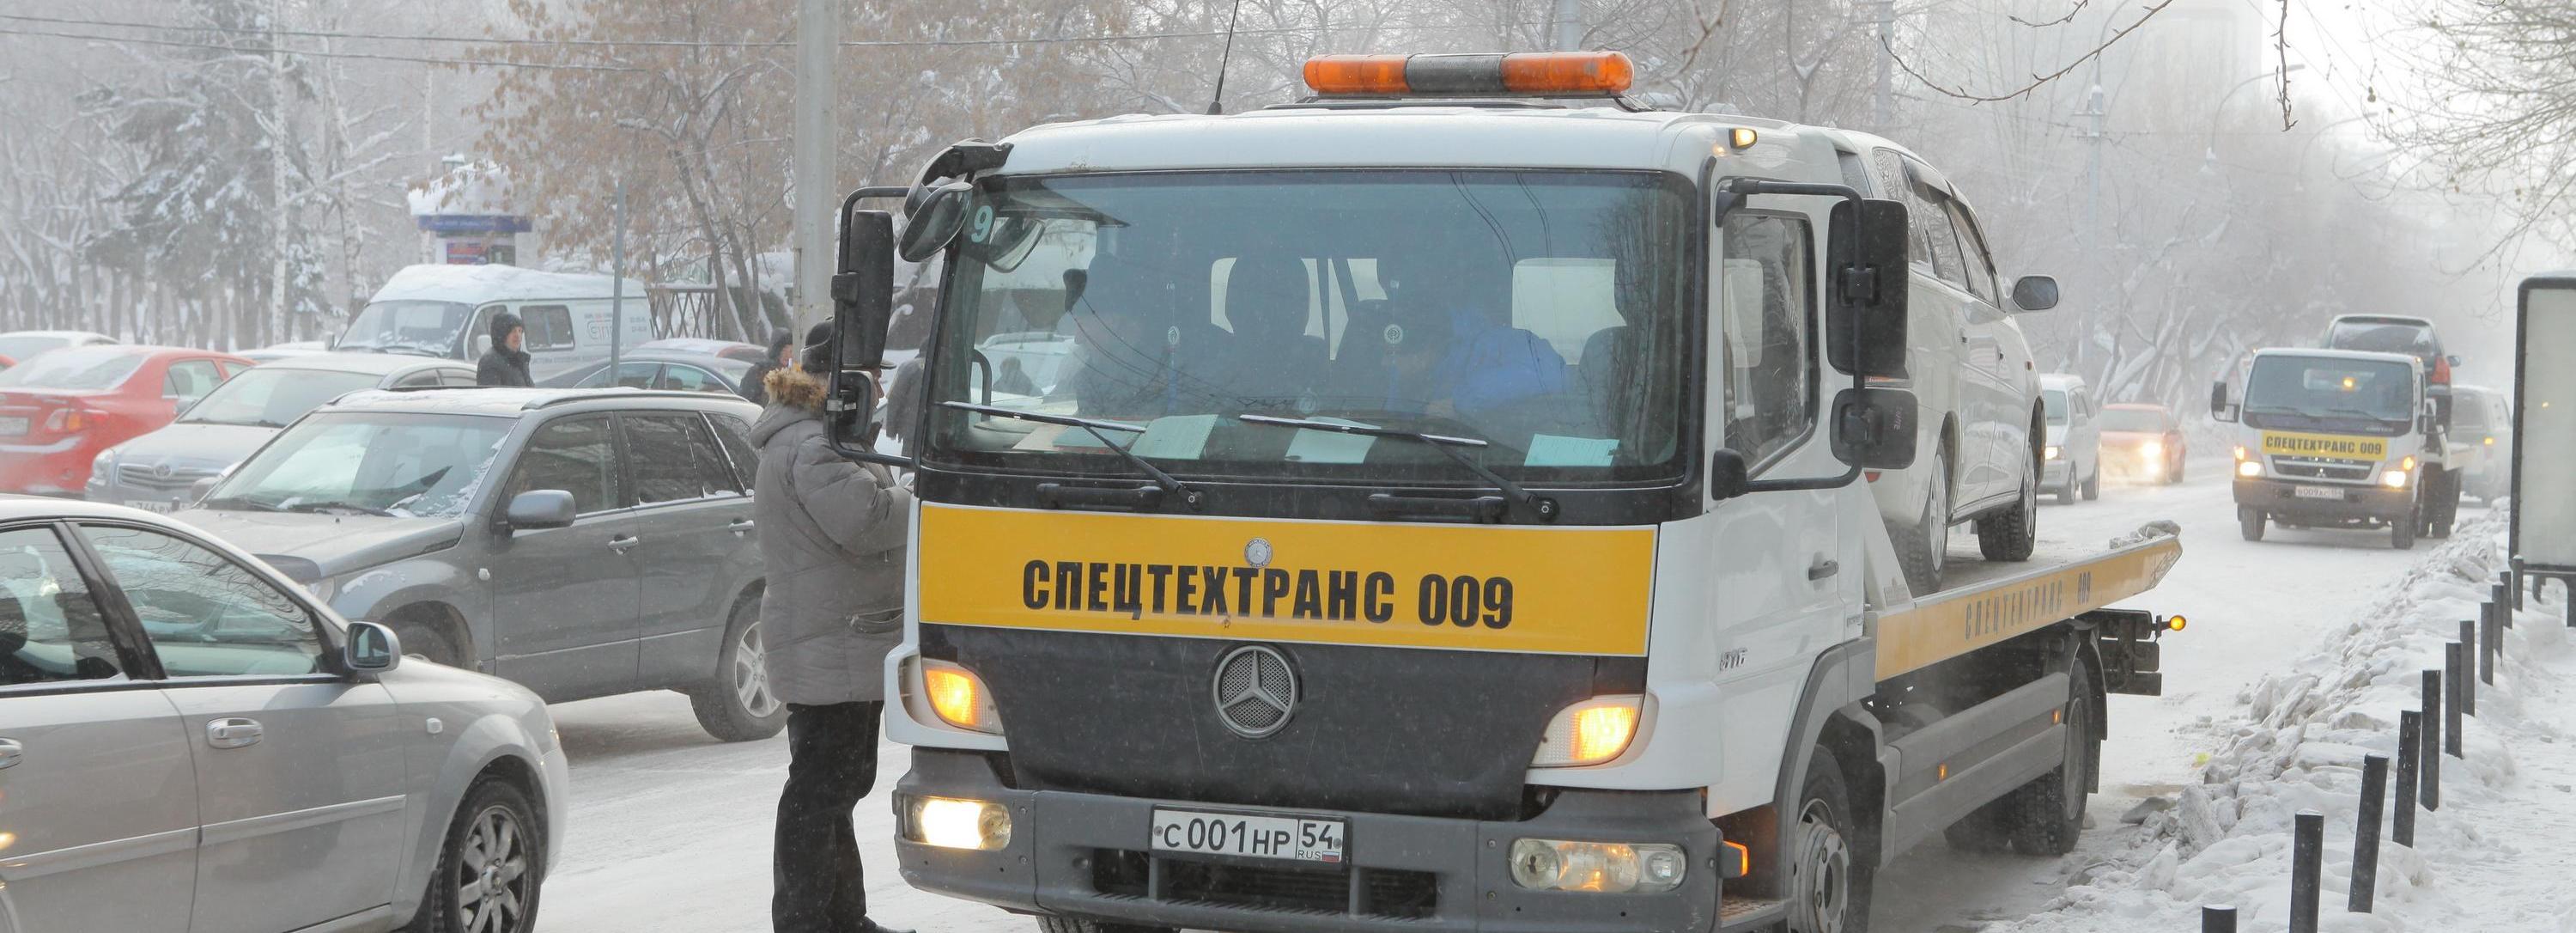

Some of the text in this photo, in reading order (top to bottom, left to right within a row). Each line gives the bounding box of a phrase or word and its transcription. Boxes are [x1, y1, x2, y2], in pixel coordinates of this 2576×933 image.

[971, 205, 993, 243] 9
[2266, 436, 2382, 454] СПЕЦТЕХТРАНС 009
[1023, 559, 1514, 630] СПЕЦТЕХТРАНС 009
[1965, 570, 2091, 640] СПЕЦТЕХТРАНС 009
[1301, 822, 1334, 850] 54
[1297, 850, 1321, 860] RUS
